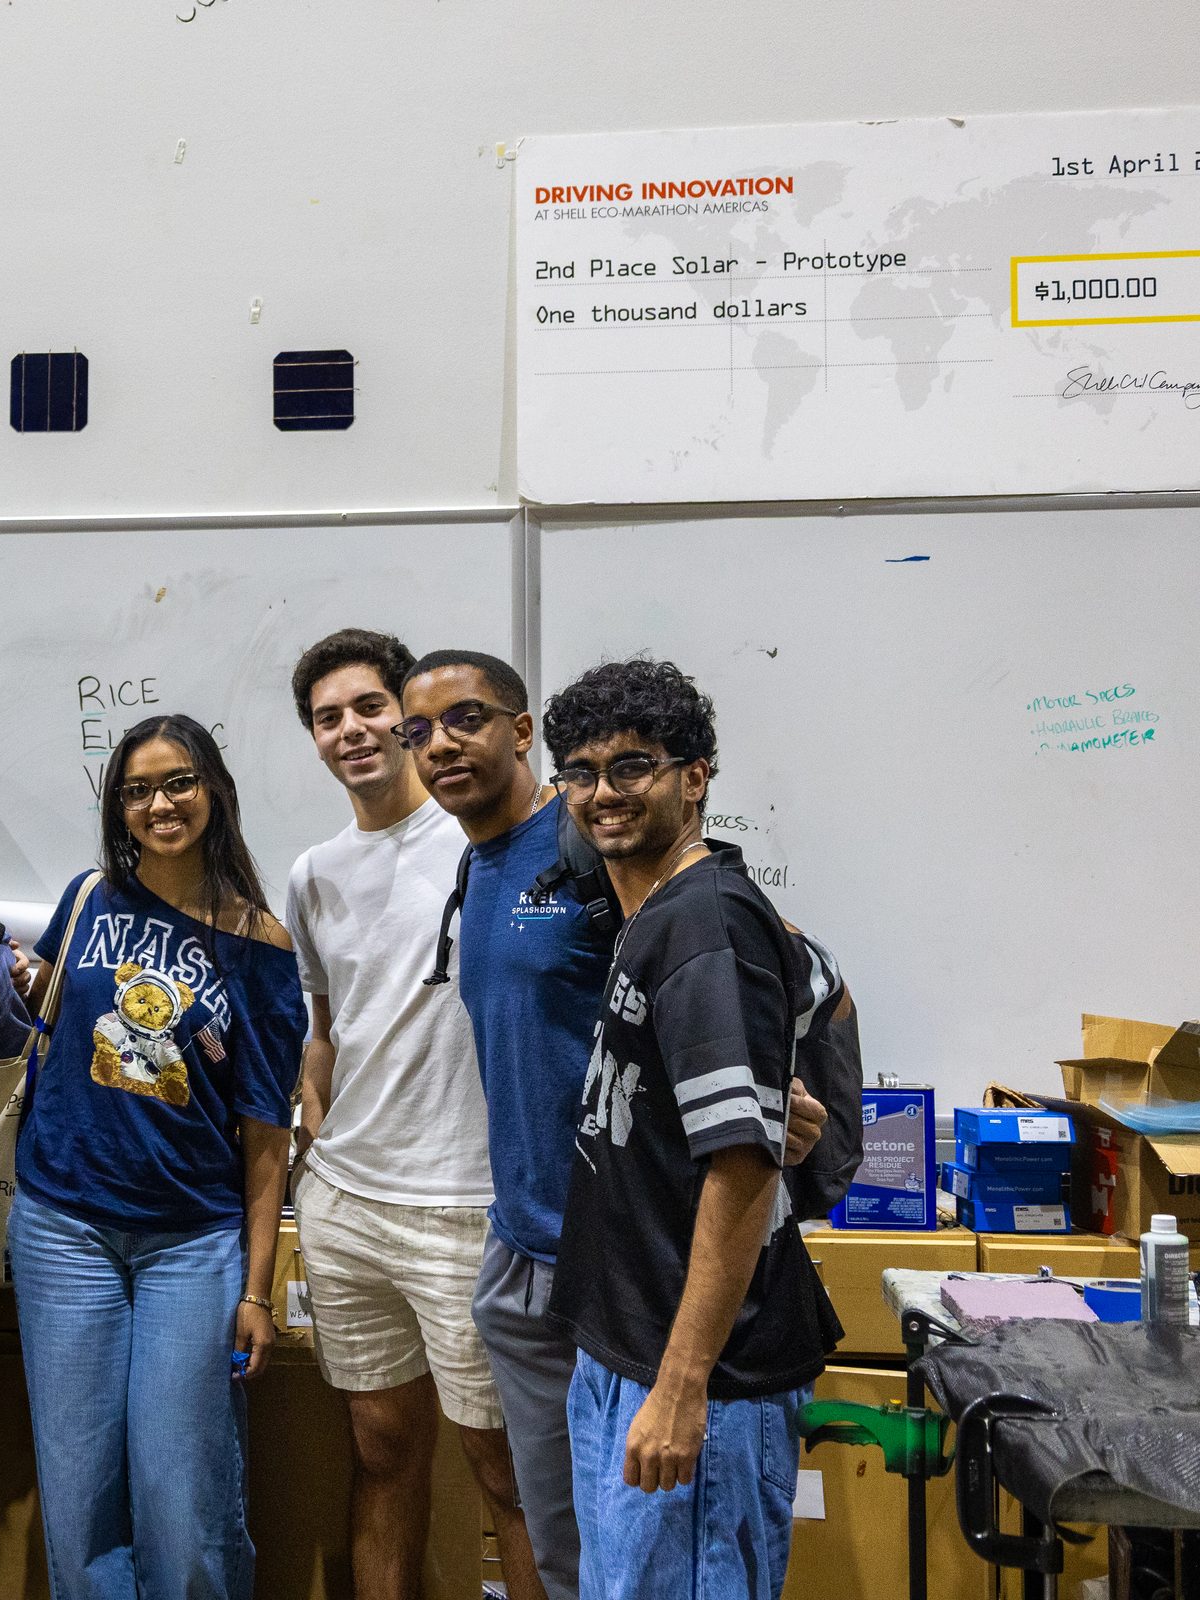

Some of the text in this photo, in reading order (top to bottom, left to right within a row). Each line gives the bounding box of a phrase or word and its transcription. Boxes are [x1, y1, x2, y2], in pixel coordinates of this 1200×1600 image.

[1051, 157, 1094, 176] 1st
[1108, 153, 1180, 177] April
[535, 176, 794, 204] DRIVING INNOVATION
[534, 201, 769, 221] AT SHELL ECO-MARATHON AMERICAS
[535, 260, 575, 280] 2nd
[590, 259, 657, 278] Place
[672, 256, 738, 275] Solar
[783, 251, 907, 273] Prototype
[1035, 277, 1157, 304] $1,000.00
[536, 299, 808, 324] One thousand dollars
[77, 675, 160, 711] RICE
[1033, 683, 1136, 712] MOTOR SPECS
[511, 906, 567, 914] SPLASHDOWN
